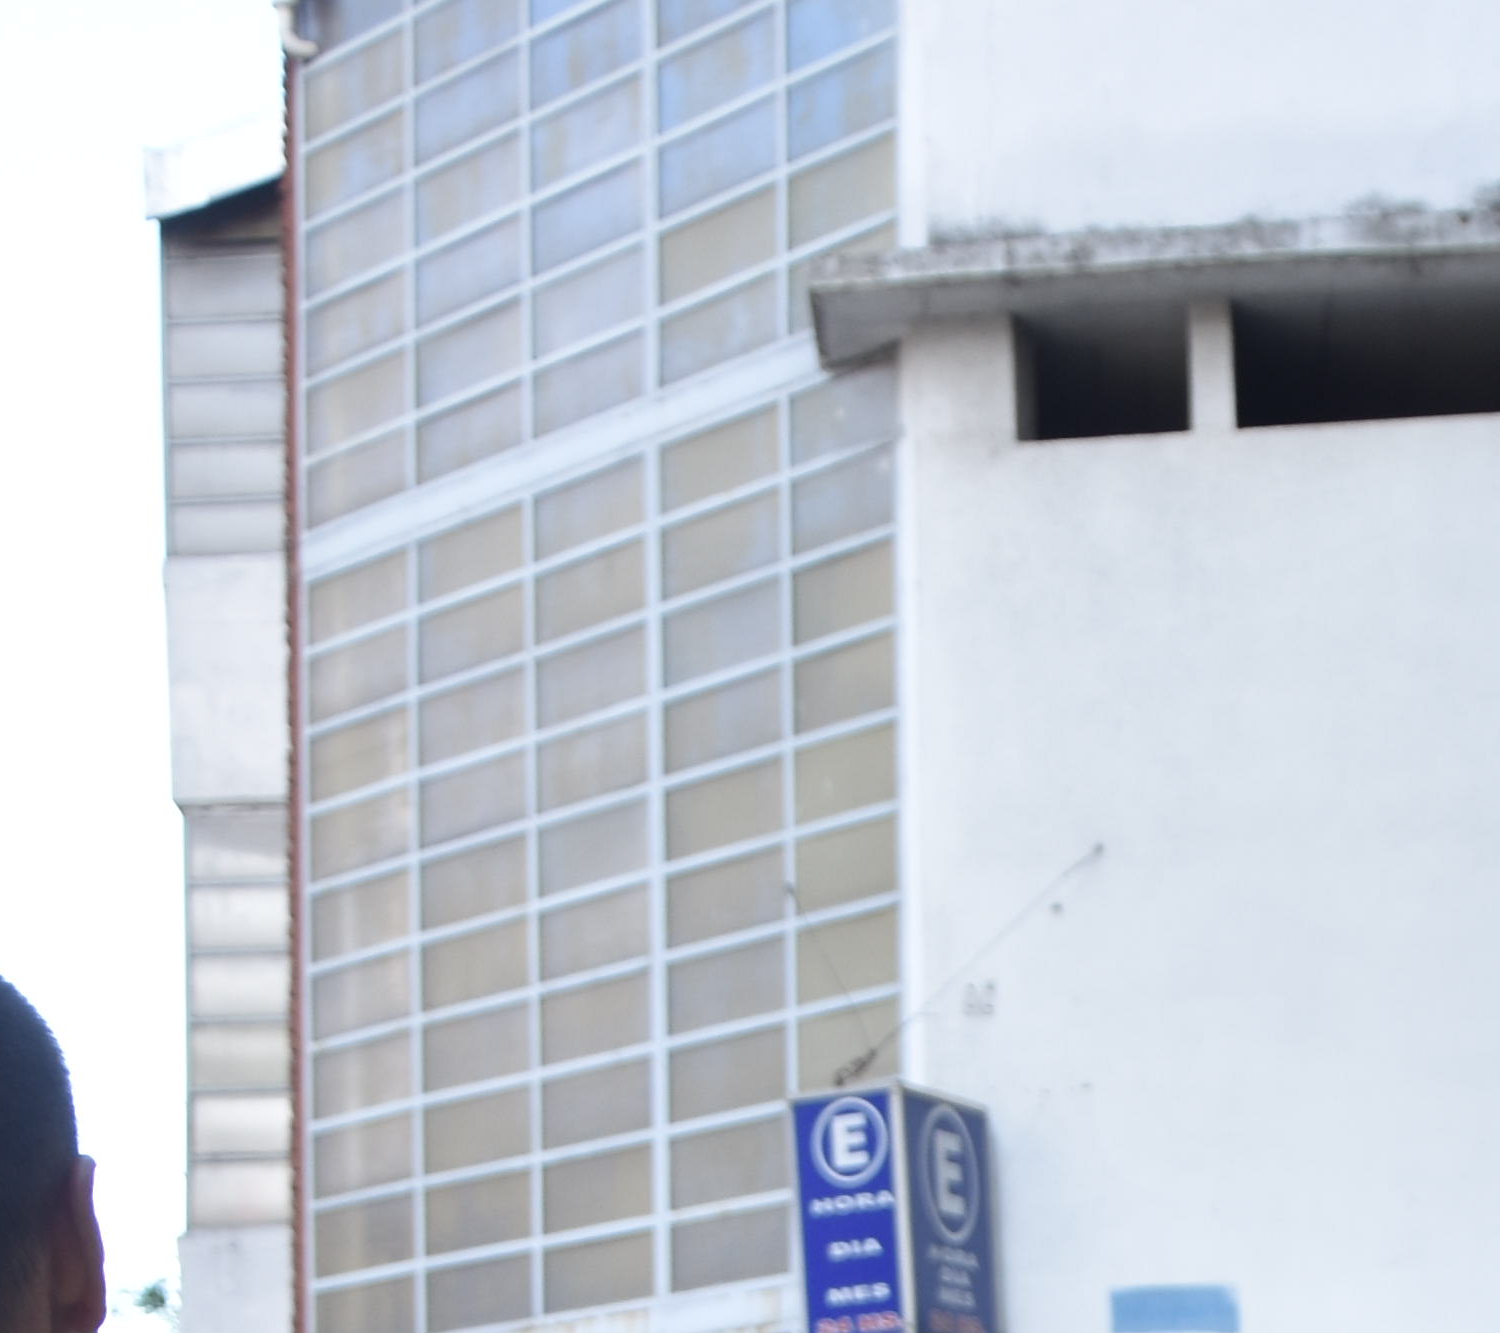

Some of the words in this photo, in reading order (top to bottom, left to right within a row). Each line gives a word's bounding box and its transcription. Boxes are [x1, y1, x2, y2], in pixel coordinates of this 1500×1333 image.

[831, 1111, 871, 1169] E
[933, 1128, 966, 1219] E
[810, 1191, 895, 1217] HORA
[827, 1238, 882, 1261] DIA
[825, 1282, 891, 1307] MES
